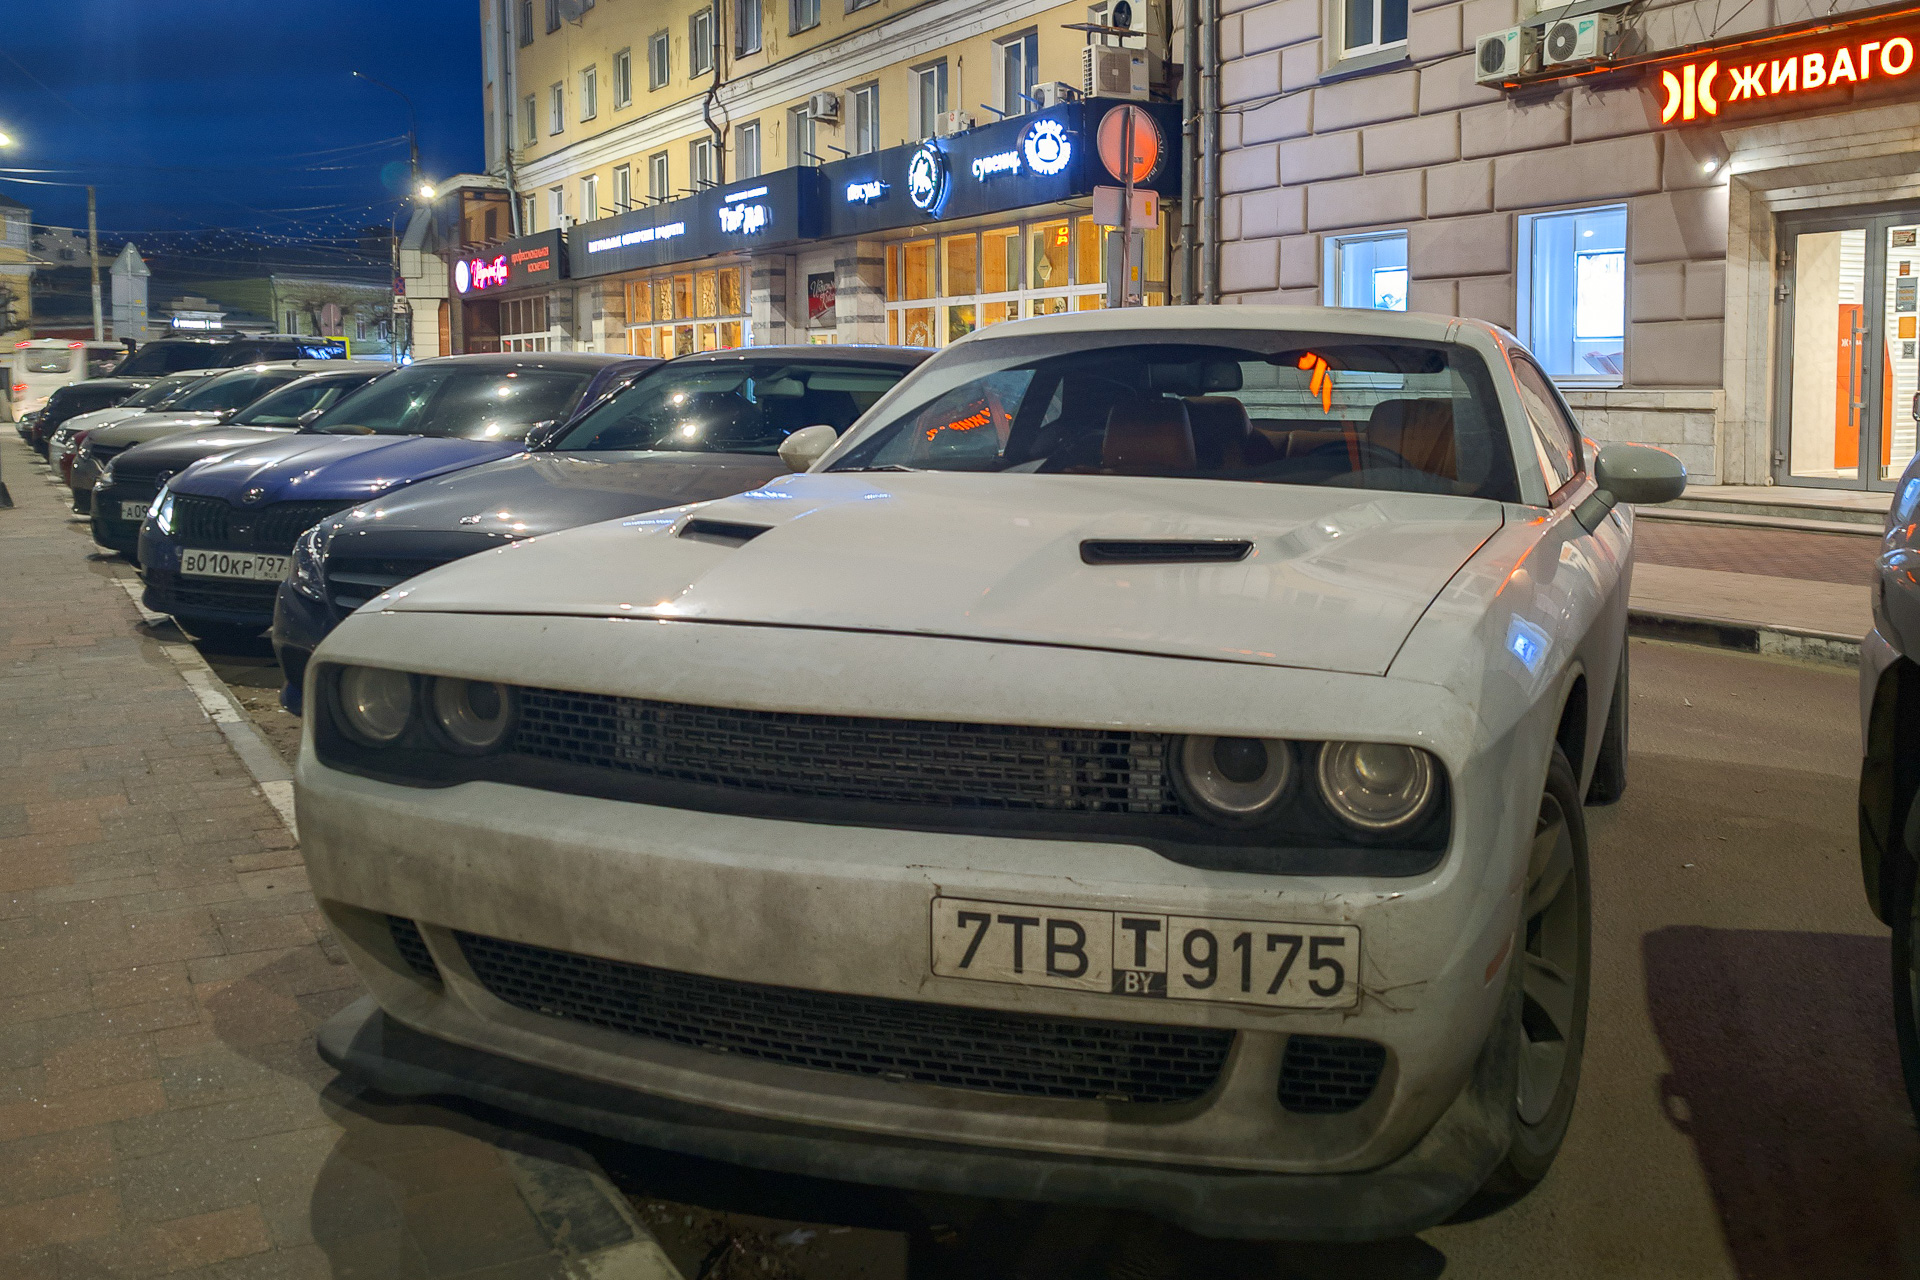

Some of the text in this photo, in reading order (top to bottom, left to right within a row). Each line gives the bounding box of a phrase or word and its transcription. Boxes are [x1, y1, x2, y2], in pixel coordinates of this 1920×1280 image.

[1727, 37, 1914, 102] ЖИВАГО
[971, 150, 1021, 182] сувенир
[186, 553, 285, 576] В010КР 797
[957, 910, 1089, 979] 7TB
[1182, 928, 1346, 998] 9175
[1125, 971, 1154, 994] BY
